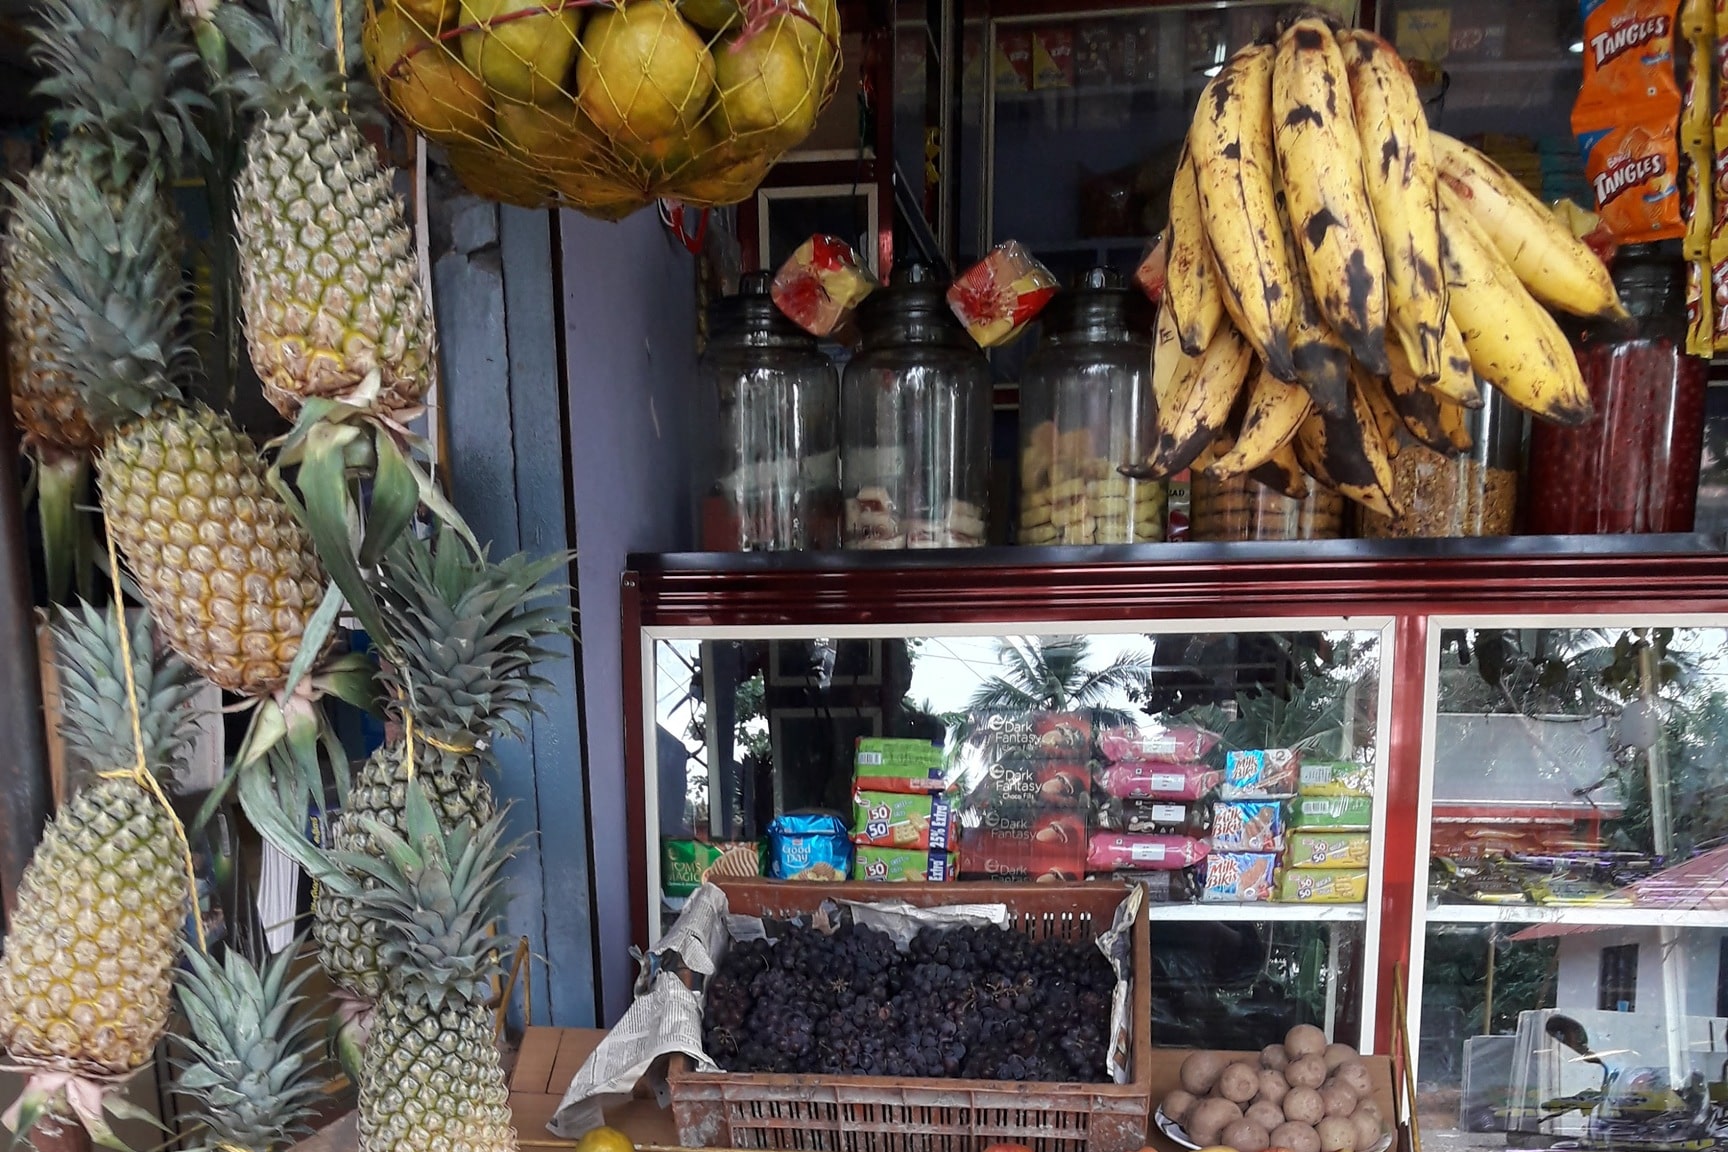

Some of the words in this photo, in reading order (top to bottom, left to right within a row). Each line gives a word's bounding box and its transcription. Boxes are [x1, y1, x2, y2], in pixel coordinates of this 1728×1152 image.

[1591, 16, 1665, 66] TANGLES
[1594, 154, 1661, 205] TANGLES
[1005, 721, 1033, 733] Dark
[995, 732, 1042, 745] Fantasy
[1005, 769, 1033, 781] Dark
[995, 780, 1042, 793] Fantasy
[871, 806, 888, 821] 50
[1213, 806, 1242, 824] Milk
[1000, 817, 1027, 829] Dark
[868, 823, 887, 837] 50
[991, 828, 1037, 841] Fantasy
[929, 828, 946, 848] 25%
[782, 843, 811, 855] Good
[786, 854, 808, 866] Day
[1313, 853, 1326, 863] 50
[868, 863, 885, 877] 50
[1000, 864, 1027, 876] Dark
[1209, 858, 1238, 876] Milk
[1205, 870, 1238, 889] Bikis
[1298, 889, 1312, 899] 50
